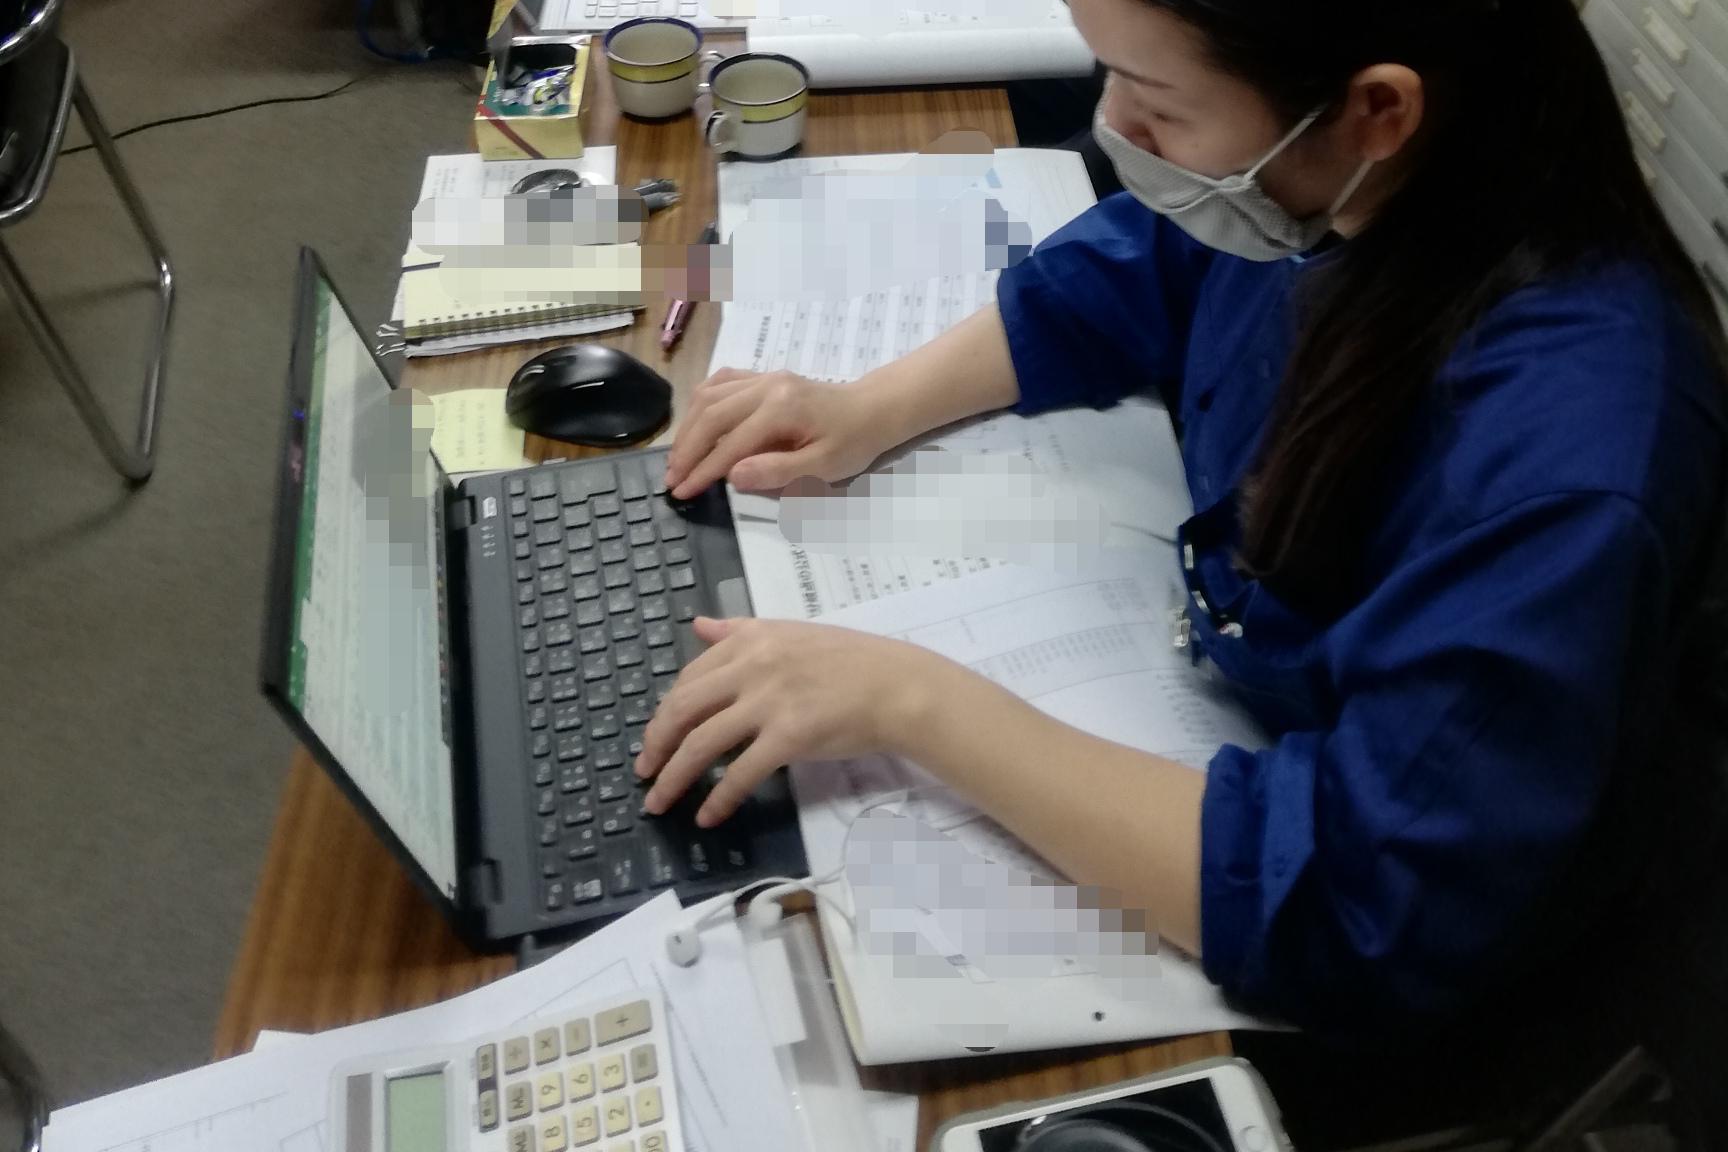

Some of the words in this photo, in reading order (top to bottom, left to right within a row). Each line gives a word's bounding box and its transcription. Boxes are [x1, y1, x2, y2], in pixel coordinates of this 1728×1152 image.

[605, 1065, 620, 1077] 3
[574, 1074, 589, 1084] 6
[542, 1085, 557, 1096] 9
[609, 1107, 624, 1121] 2
[577, 1117, 593, 1129] 5
[545, 1126, 561, 1138] 8
